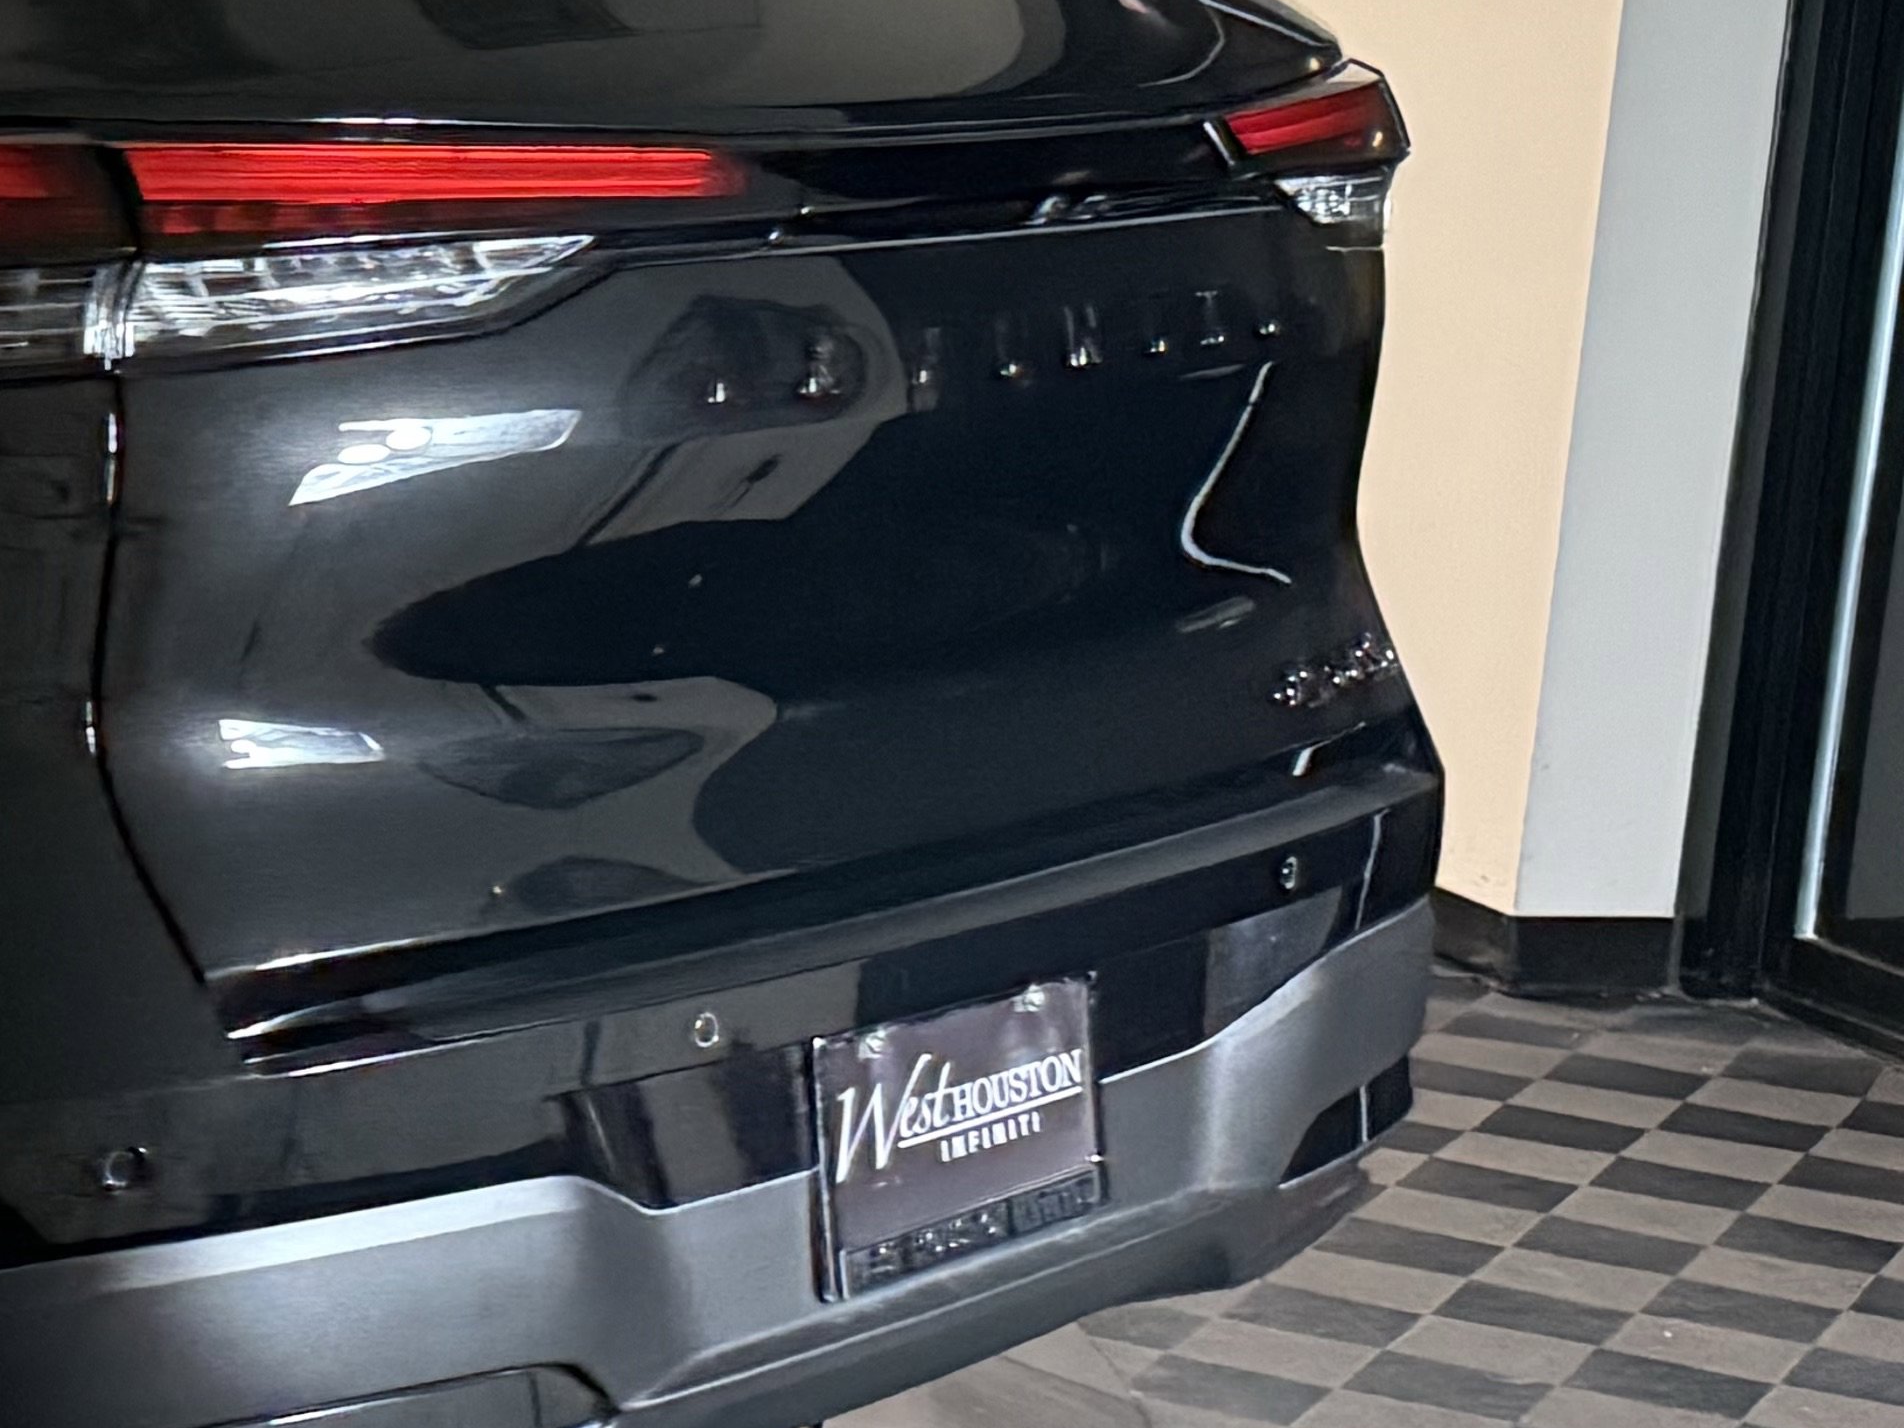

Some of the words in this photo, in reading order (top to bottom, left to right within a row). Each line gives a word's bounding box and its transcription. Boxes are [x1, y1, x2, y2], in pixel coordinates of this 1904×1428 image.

[835, 1053, 956, 1184] West
[951, 1048, 1083, 1121] HOUSTON
[939, 1111, 1043, 1163] INFINITI
